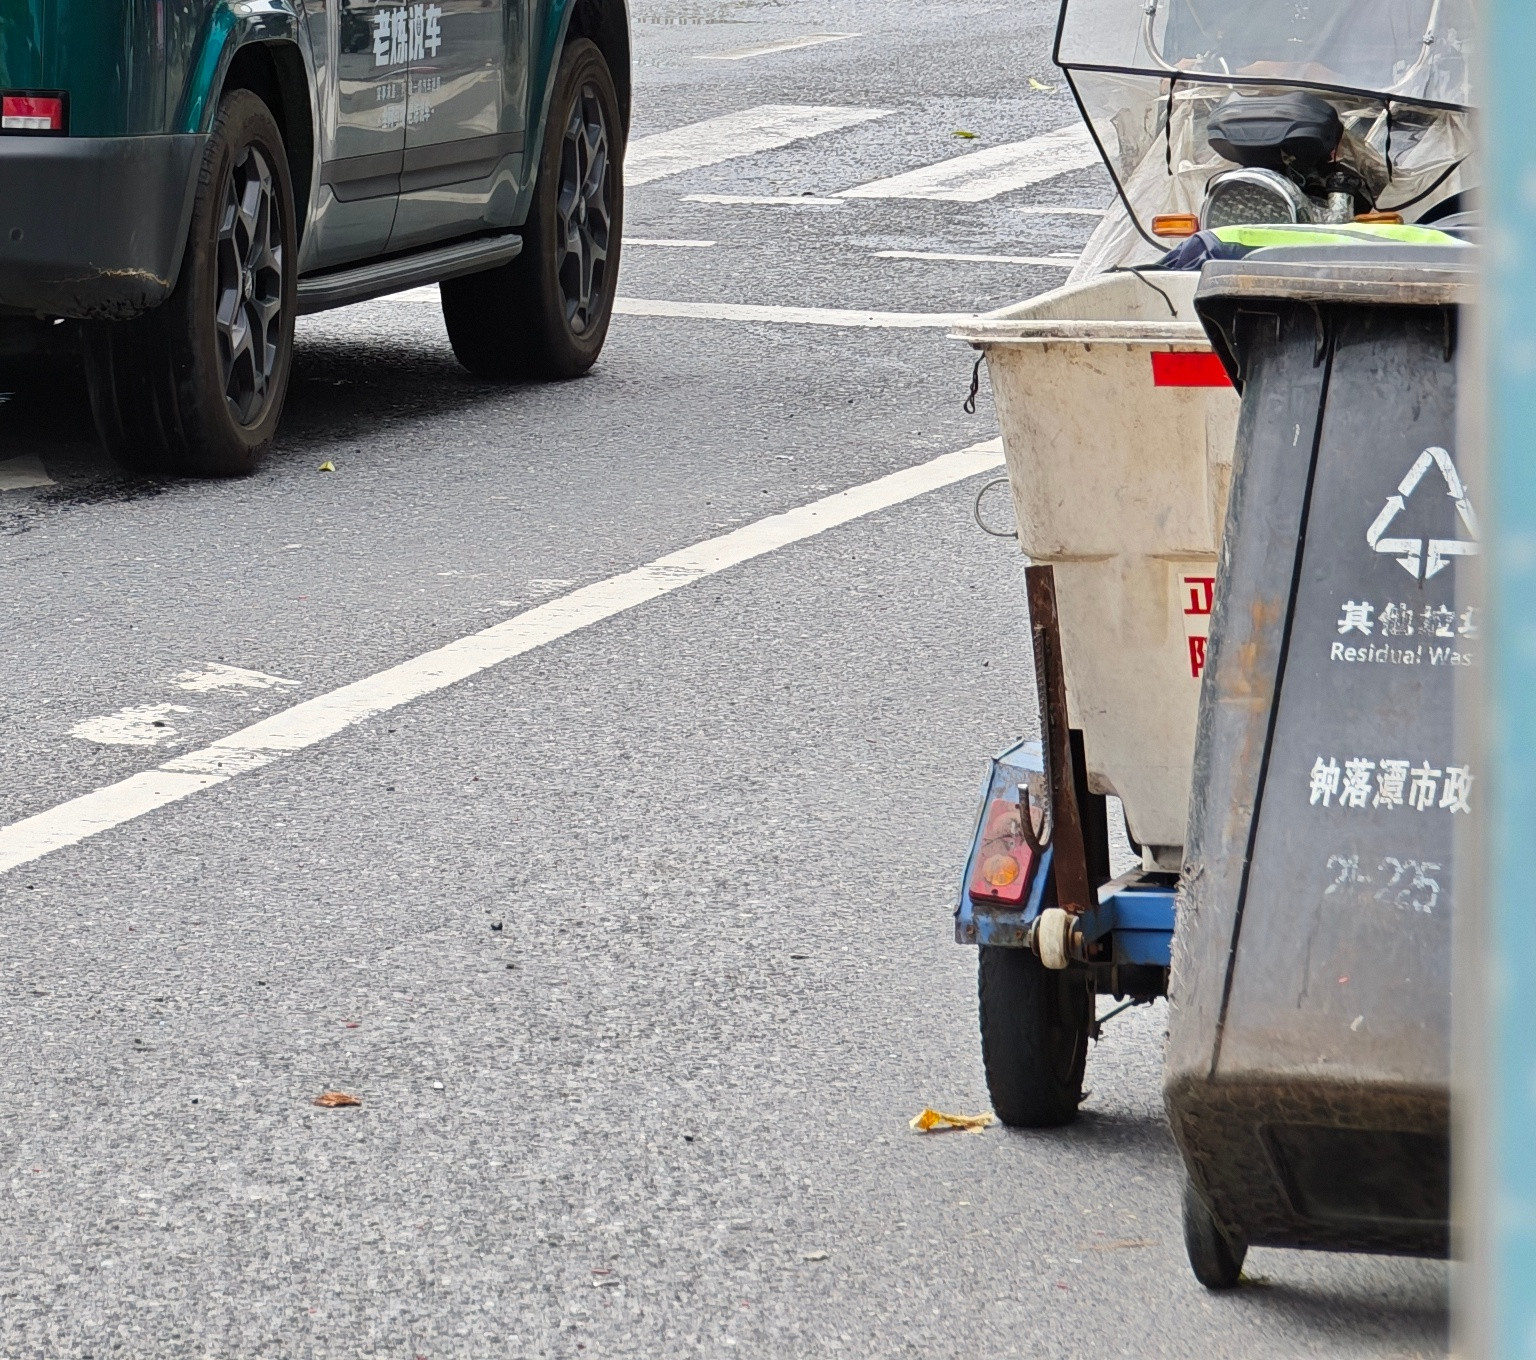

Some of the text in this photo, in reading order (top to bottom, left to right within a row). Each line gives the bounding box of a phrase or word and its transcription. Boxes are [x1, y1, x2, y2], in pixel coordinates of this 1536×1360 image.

[1330, 642, 1423, 665] Residual
[1309, 756, 1476, 815] 钟落潭市政
